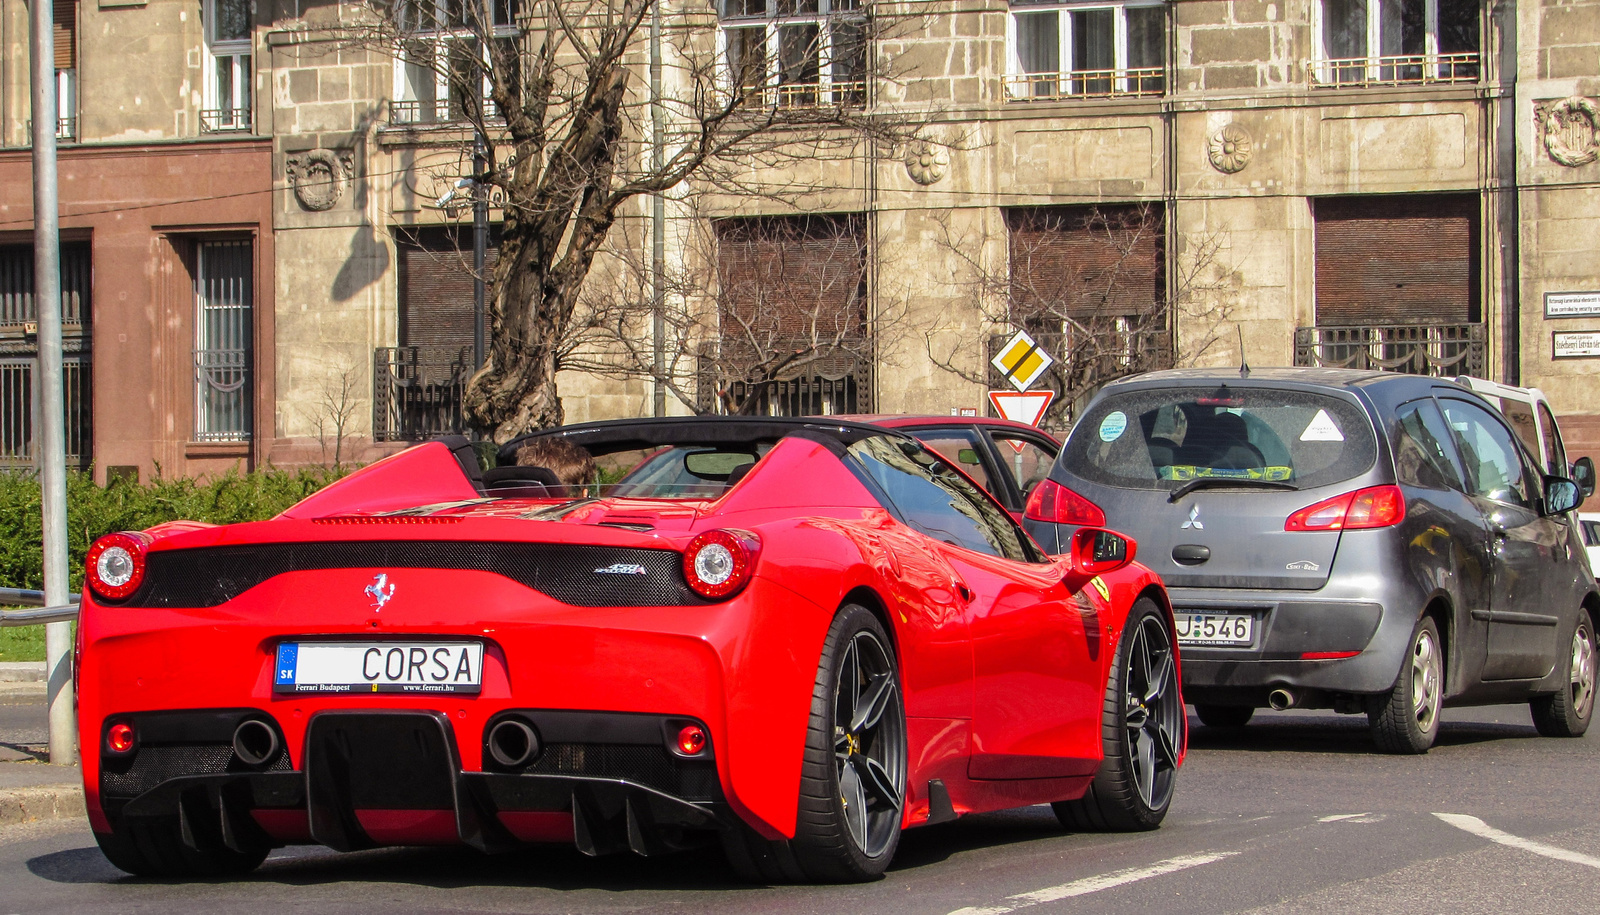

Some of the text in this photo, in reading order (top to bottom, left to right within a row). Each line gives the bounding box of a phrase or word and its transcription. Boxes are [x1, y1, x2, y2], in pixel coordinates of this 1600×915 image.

[363, 647, 472, 681] CORSA
[280, 669, 293, 679] SK
[319, 684, 350, 692] Budapest
